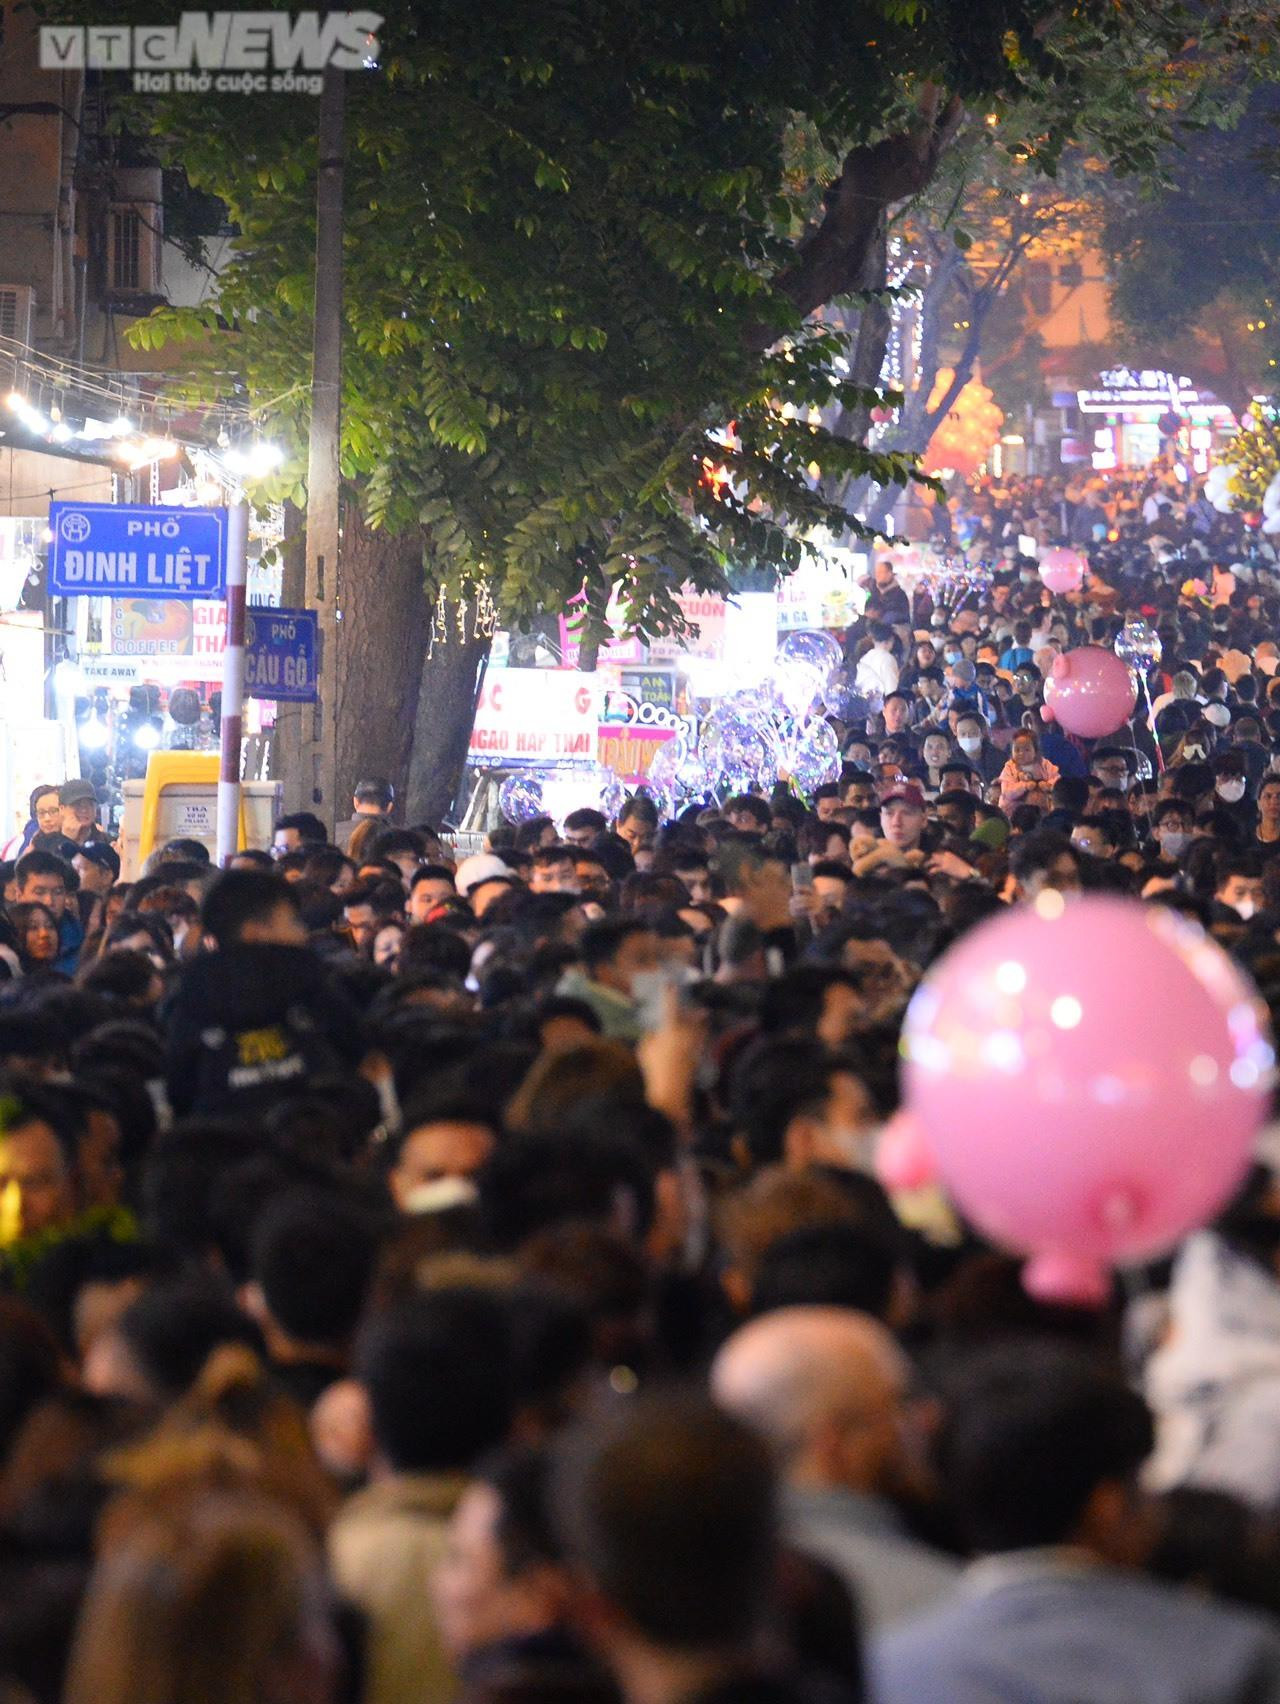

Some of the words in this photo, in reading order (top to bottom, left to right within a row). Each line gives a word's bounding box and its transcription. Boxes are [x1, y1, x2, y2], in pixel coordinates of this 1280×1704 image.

[127, 515, 182, 538] PHỐ
[65, 550, 138, 583] ĐINH
[147, 546, 212, 590] LIỆT
[115, 641, 179, 653] COFFEE
[85, 667, 108, 676] TAKE
[111, 667, 137, 677] AWAY
[284, 643, 307, 688] GỖ
